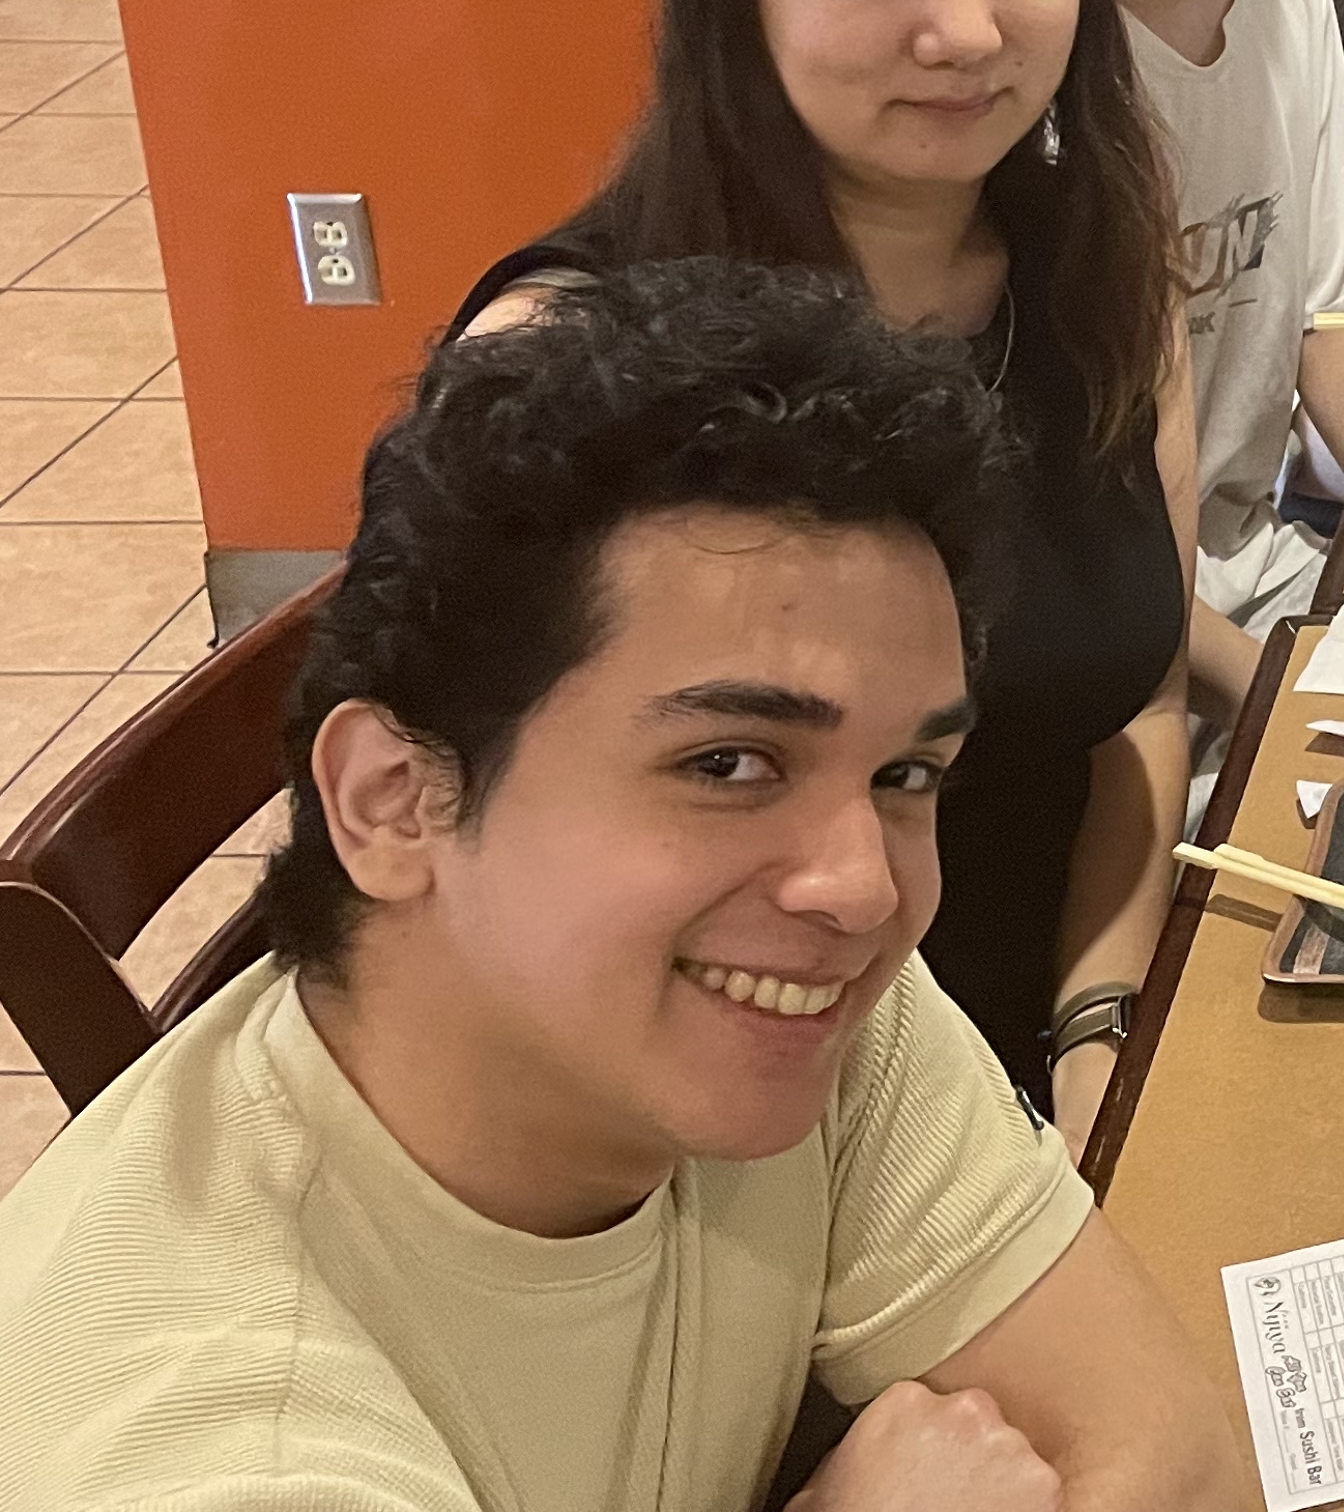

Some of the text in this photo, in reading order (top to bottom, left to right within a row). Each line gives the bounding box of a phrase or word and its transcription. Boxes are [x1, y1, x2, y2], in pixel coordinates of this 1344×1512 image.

[1262, 1302, 1289, 1354] Nijiya
[1300, 1431, 1321, 1464] Sushi
[1307, 1466, 1323, 1485] Bar
